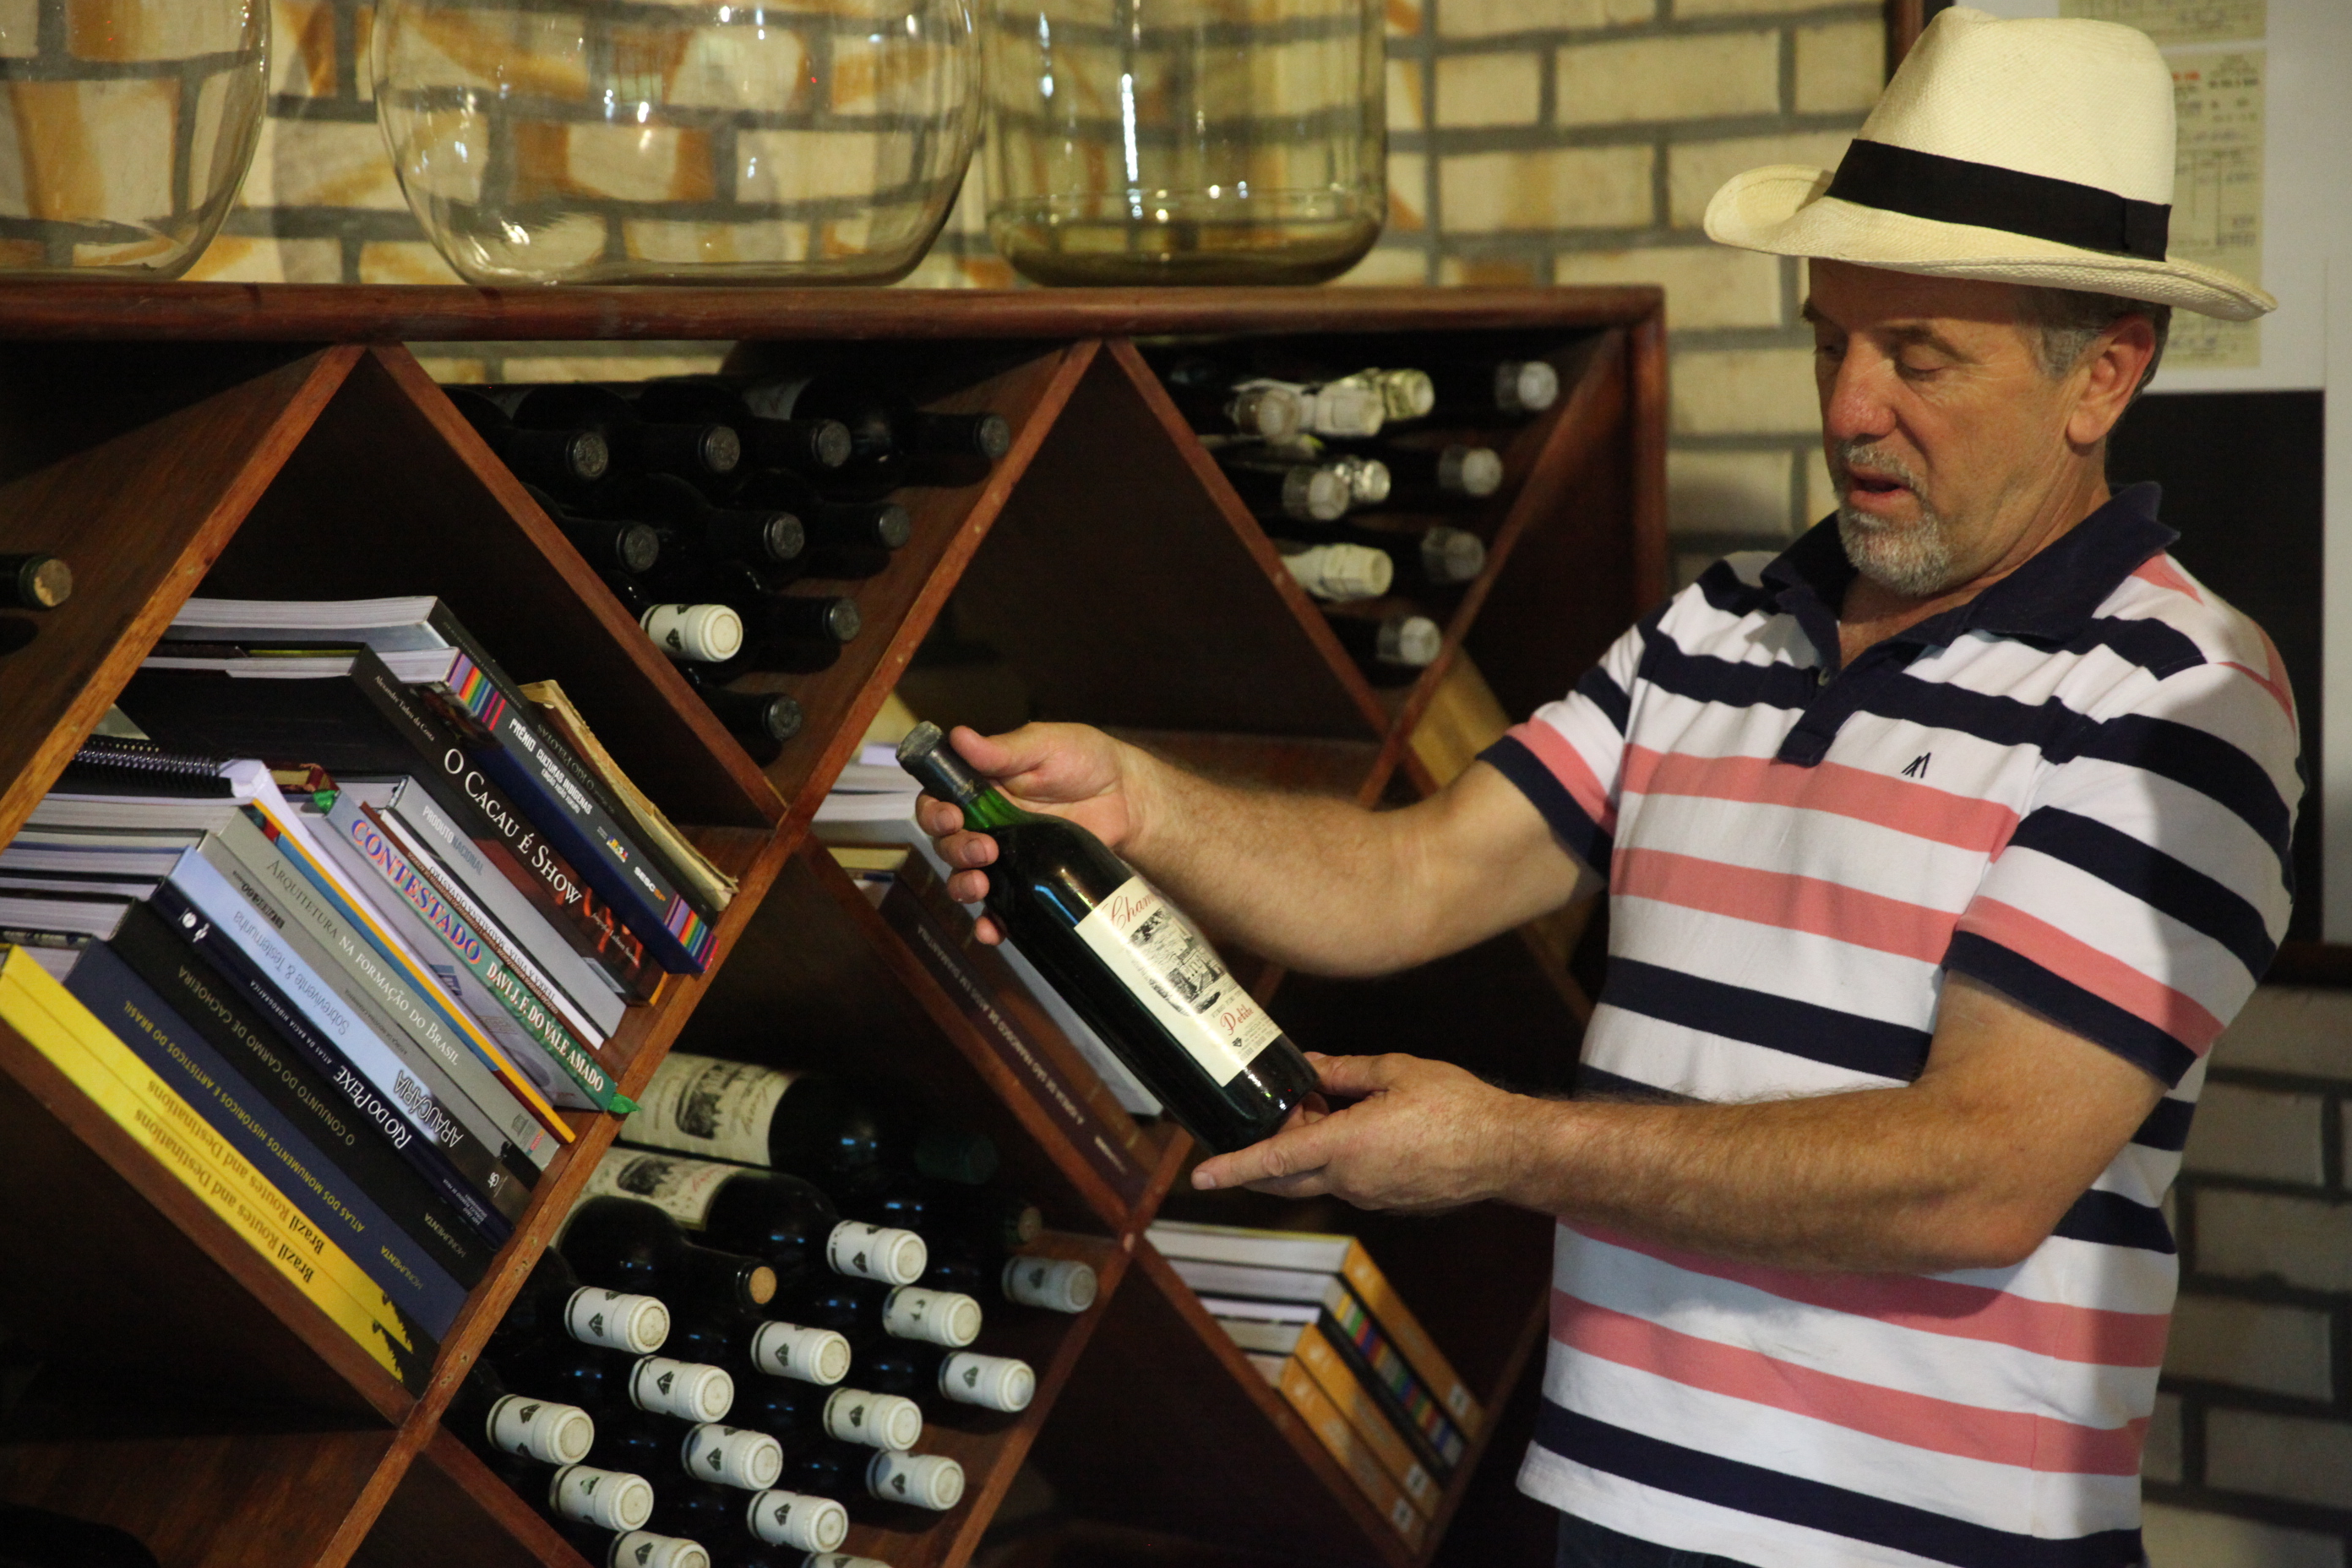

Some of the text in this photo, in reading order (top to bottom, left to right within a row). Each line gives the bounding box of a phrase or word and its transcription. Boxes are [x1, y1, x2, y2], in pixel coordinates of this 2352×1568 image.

[374, 675, 400, 703] Alexandre
[399, 700, 414, 719] Tadeu
[419, 723, 435, 742] Costa
[509, 718, 592, 814] PRÊMIO CULTURAS INDÍGENAS
[537, 724, 573, 765] PELOTAS
[444, 748, 465, 775] O
[517, 832, 535, 854] É
[233, 911, 286, 972] Testemunha
[266, 859, 338, 939] ARQUITETURA
[339, 935, 355, 956] NA
[354, 952, 410, 1011] FORMAÇÃO
[408, 1009, 426, 1028] DO
[465, 905, 506, 948] MADALENA
[285, 964, 296, 980] &
[351, 819, 481, 964] CONTESTADO
[486, 961, 514, 995] DAVI
[509, 988, 520, 1004] J.
[518, 997, 534, 1015] F.
[527, 1006, 545, 1029] DO
[544, 1021, 569, 1056] VALE
[567, 1049, 604, 1092] AMADO
[506, 948, 529, 972] VISTA
[178, 966, 232, 1024] CACHOEIRA
[250, 980, 290, 1021] HIDROGRÁFICA
[294, 972, 350, 1036] Sobrevivente
[531, 975, 557, 1001] TERRA
[124, 1001, 154, 1032] BRASIL
[153, 1029, 168, 1046] DO
[231, 1021, 248, 1037] DE
[289, 1021, 307, 1038] BACIA
[166, 1043, 215, 1089] ARTÍSTICOS
[246, 1035, 282, 1073] CARMO
[315, 1047, 332, 1064] ATLAS
[281, 1070, 299, 1089] DO
[220, 1092, 268, 1141] HISTÓRICOS
[297, 1085, 346, 1137] CONJUNTO
[333, 1064, 412, 1150] RIO DO PEIXE
[393, 1070, 464, 1149] ARAUCÁRIA
[143, 1081, 325, 1255] Brazil Routes and Destinations
[266, 1137, 324, 1195] MONUMENTOS
[133, 1109, 314, 1283] Brazil Routes and Destinations
[323, 1190, 341, 1211] DOS
[339, 1207, 365, 1233] ATLAS
[424, 1213, 466, 1256] MONUMENTA
[380, 1245, 423, 1289] MONUMENTA
